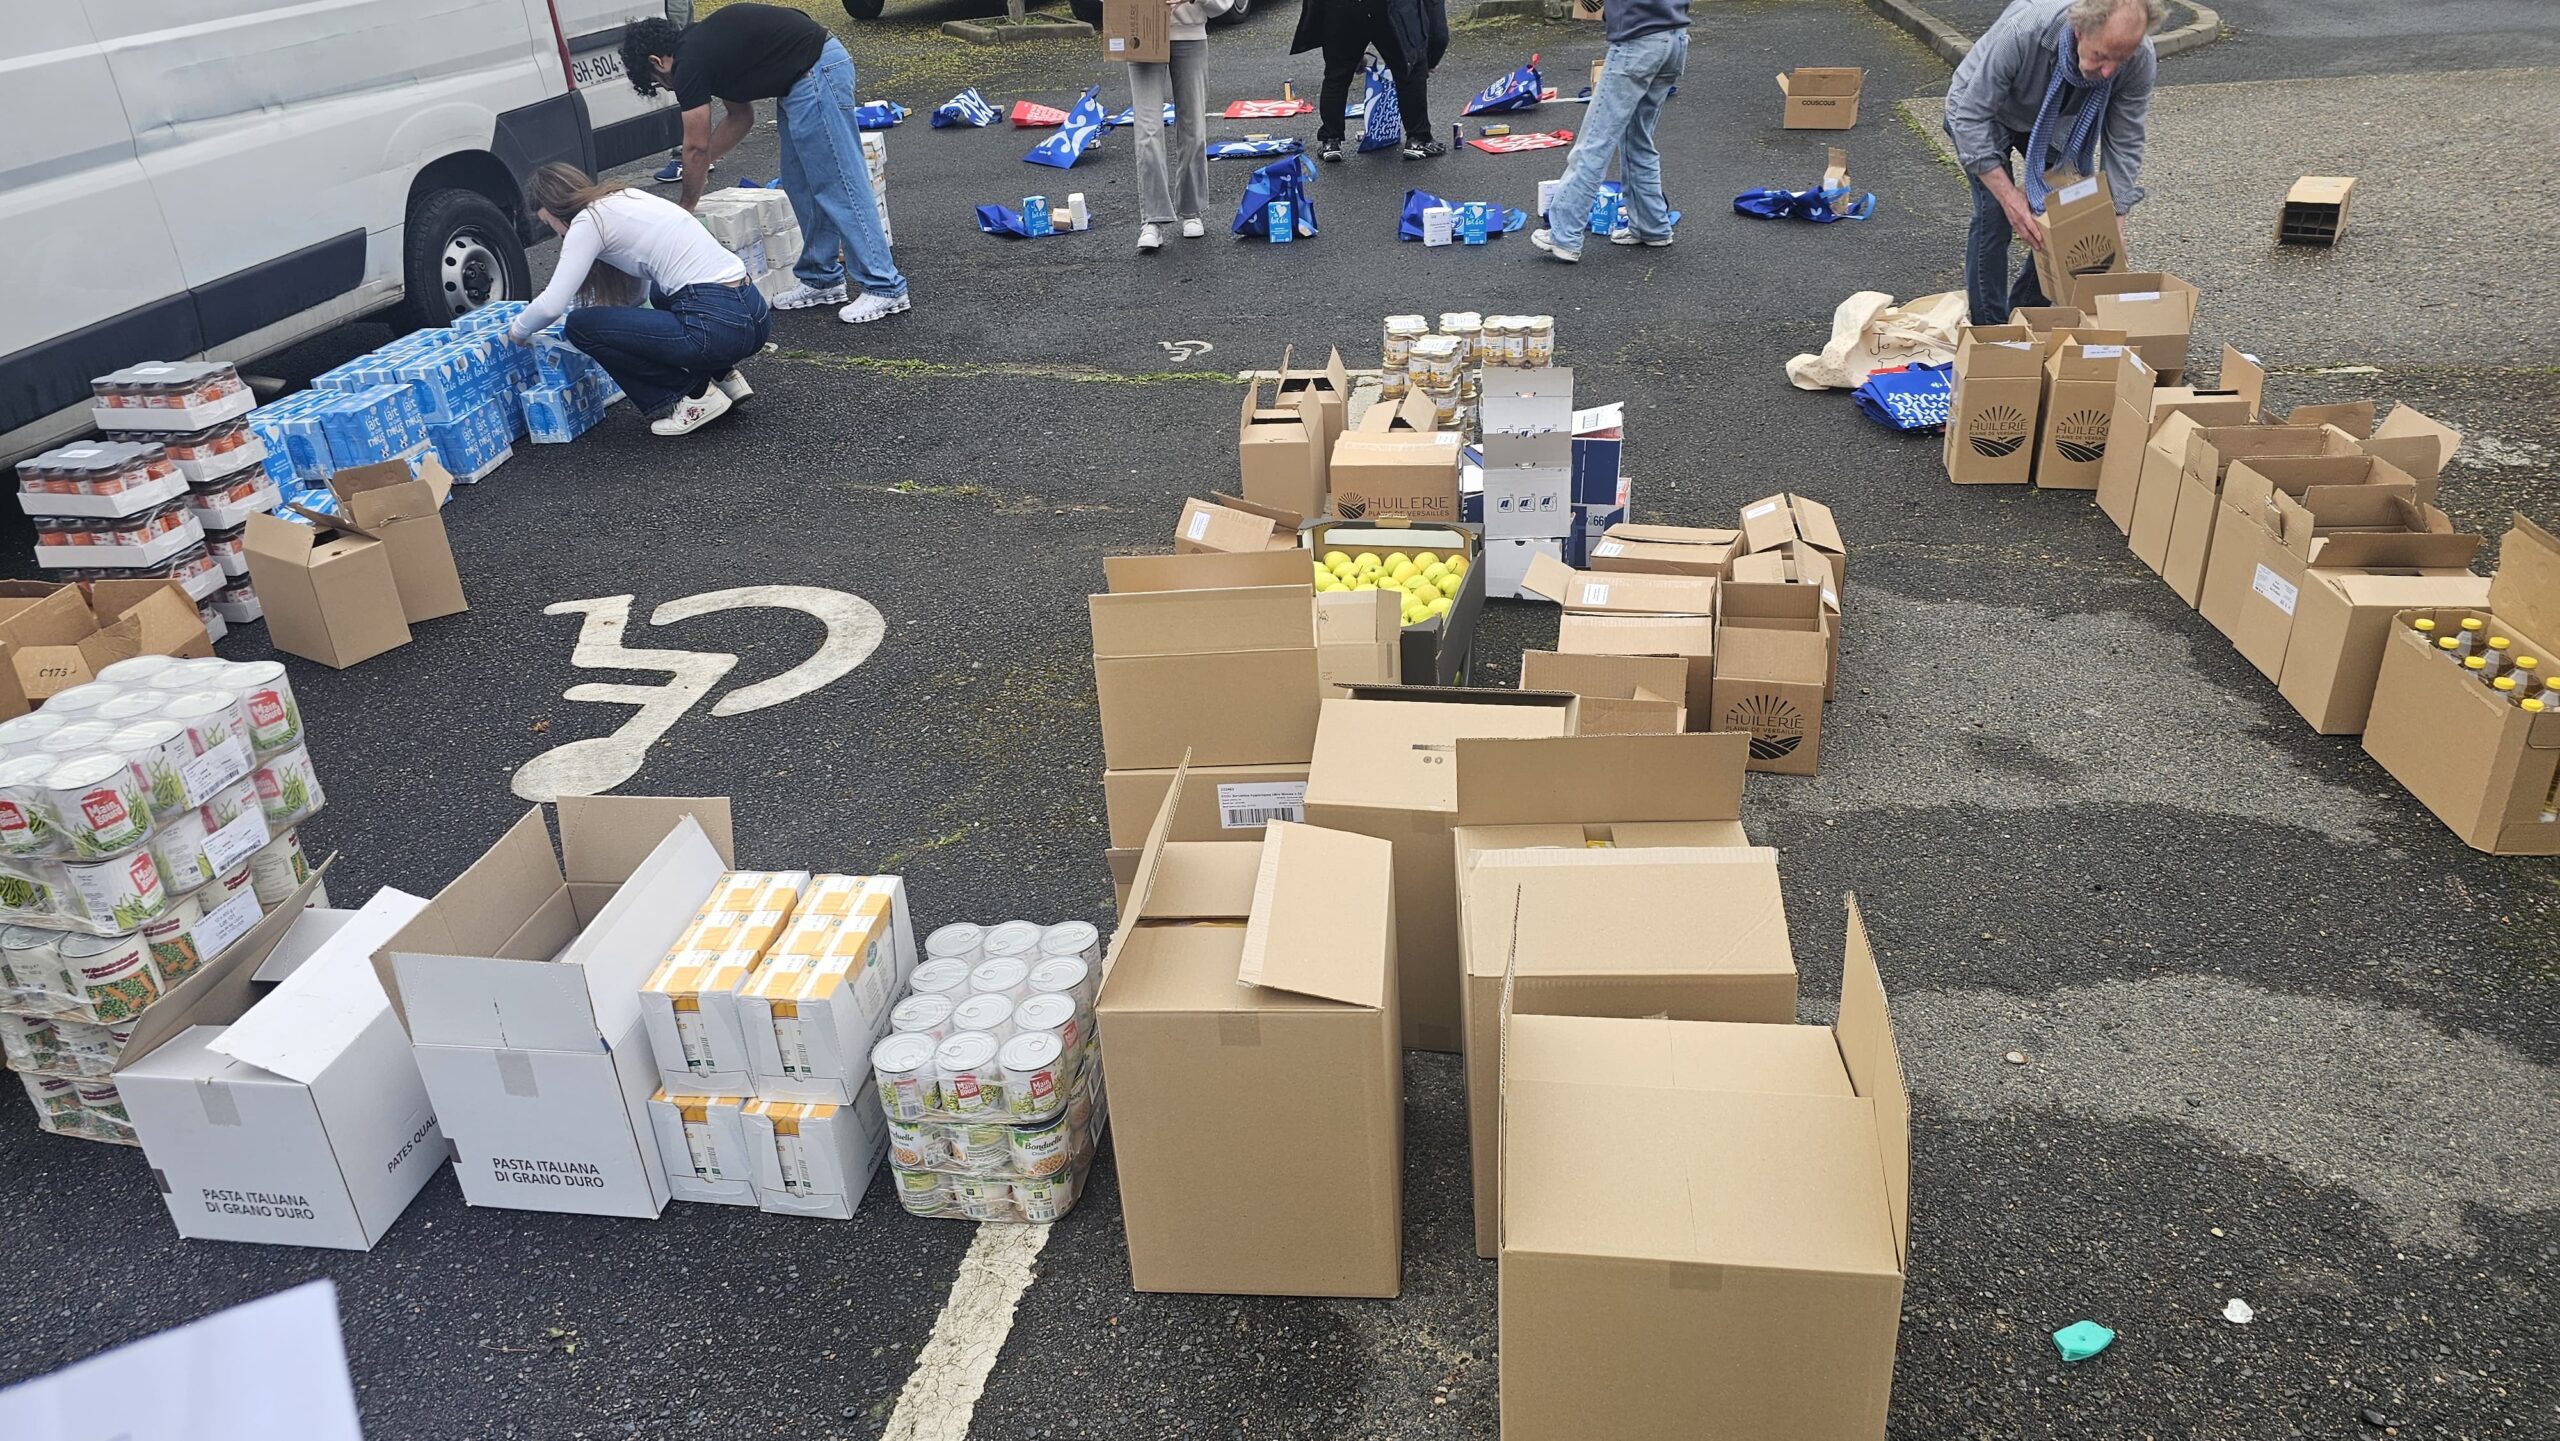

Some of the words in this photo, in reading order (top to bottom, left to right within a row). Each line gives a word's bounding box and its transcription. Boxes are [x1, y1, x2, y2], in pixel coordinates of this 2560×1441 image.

[1969, 421, 2029, 431] HUILERIE
[2056, 425, 2109, 437] HUILERI
[1368, 496, 1449, 510] HUILERIE
[39, 668, 68, 678] C175
[1726, 713, 1805, 730] HUILERIE
[1763, 727, 1804, 735] VERSAILLES
[86, 801, 118, 818] Main
[1025, 1134, 1063, 1150] Bonduelle
[387, 1140, 413, 1174] PATES
[493, 1158, 535, 1171] PASTA
[536, 1160, 601, 1175] ITALIANA
[494, 1170, 510, 1182] DI
[512, 1172, 561, 1185] GRANO
[564, 1175, 604, 1188] DURO
[202, 1188, 244, 1202] PASTA
[245, 1192, 310, 1207] ITALIANA
[205, 1201, 221, 1213] DI
[223, 1203, 272, 1217] GRANO
[274, 1206, 315, 1220] DURO
